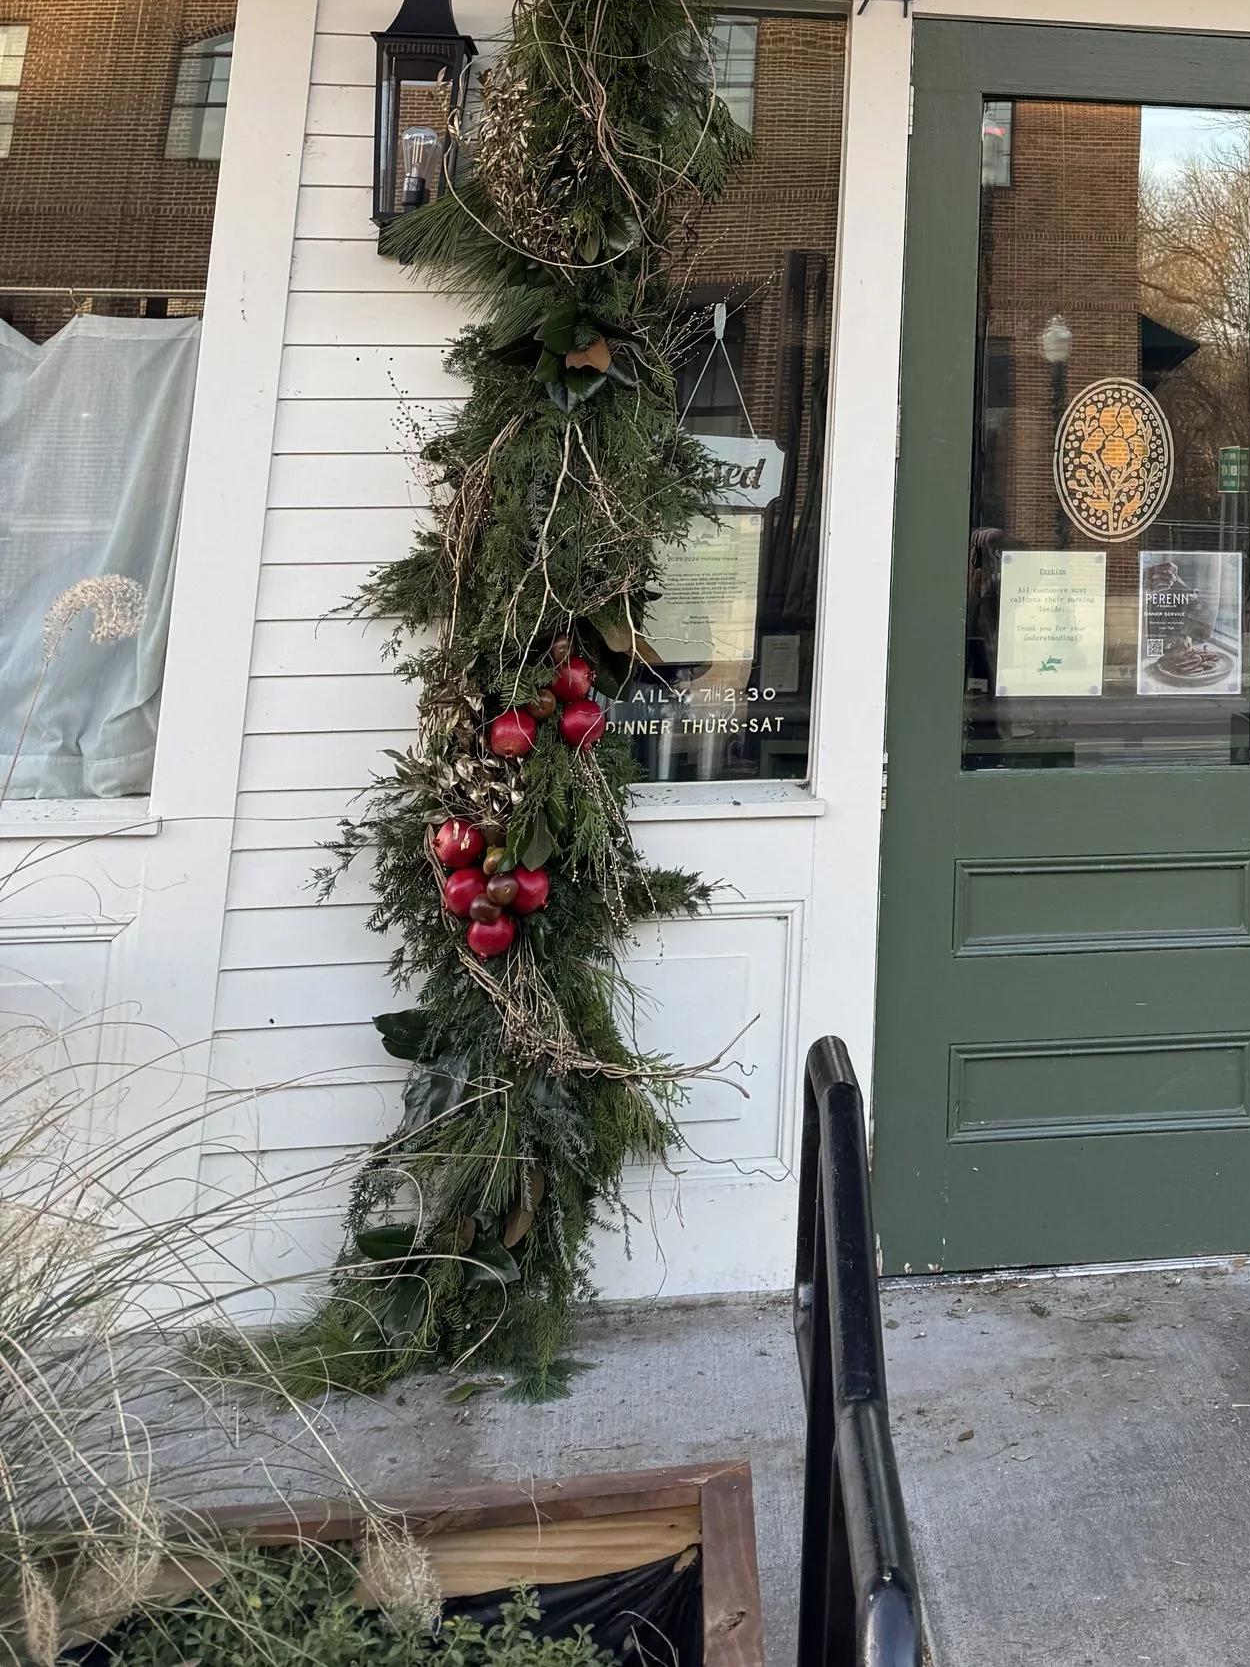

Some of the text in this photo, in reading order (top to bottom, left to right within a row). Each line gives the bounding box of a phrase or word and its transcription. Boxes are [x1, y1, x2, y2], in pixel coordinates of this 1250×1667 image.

[1145, 593, 1189, 605] PERENN
[615, 688, 688, 704] AILY
[605, 716, 785, 735] DINNER THURS-SAT
